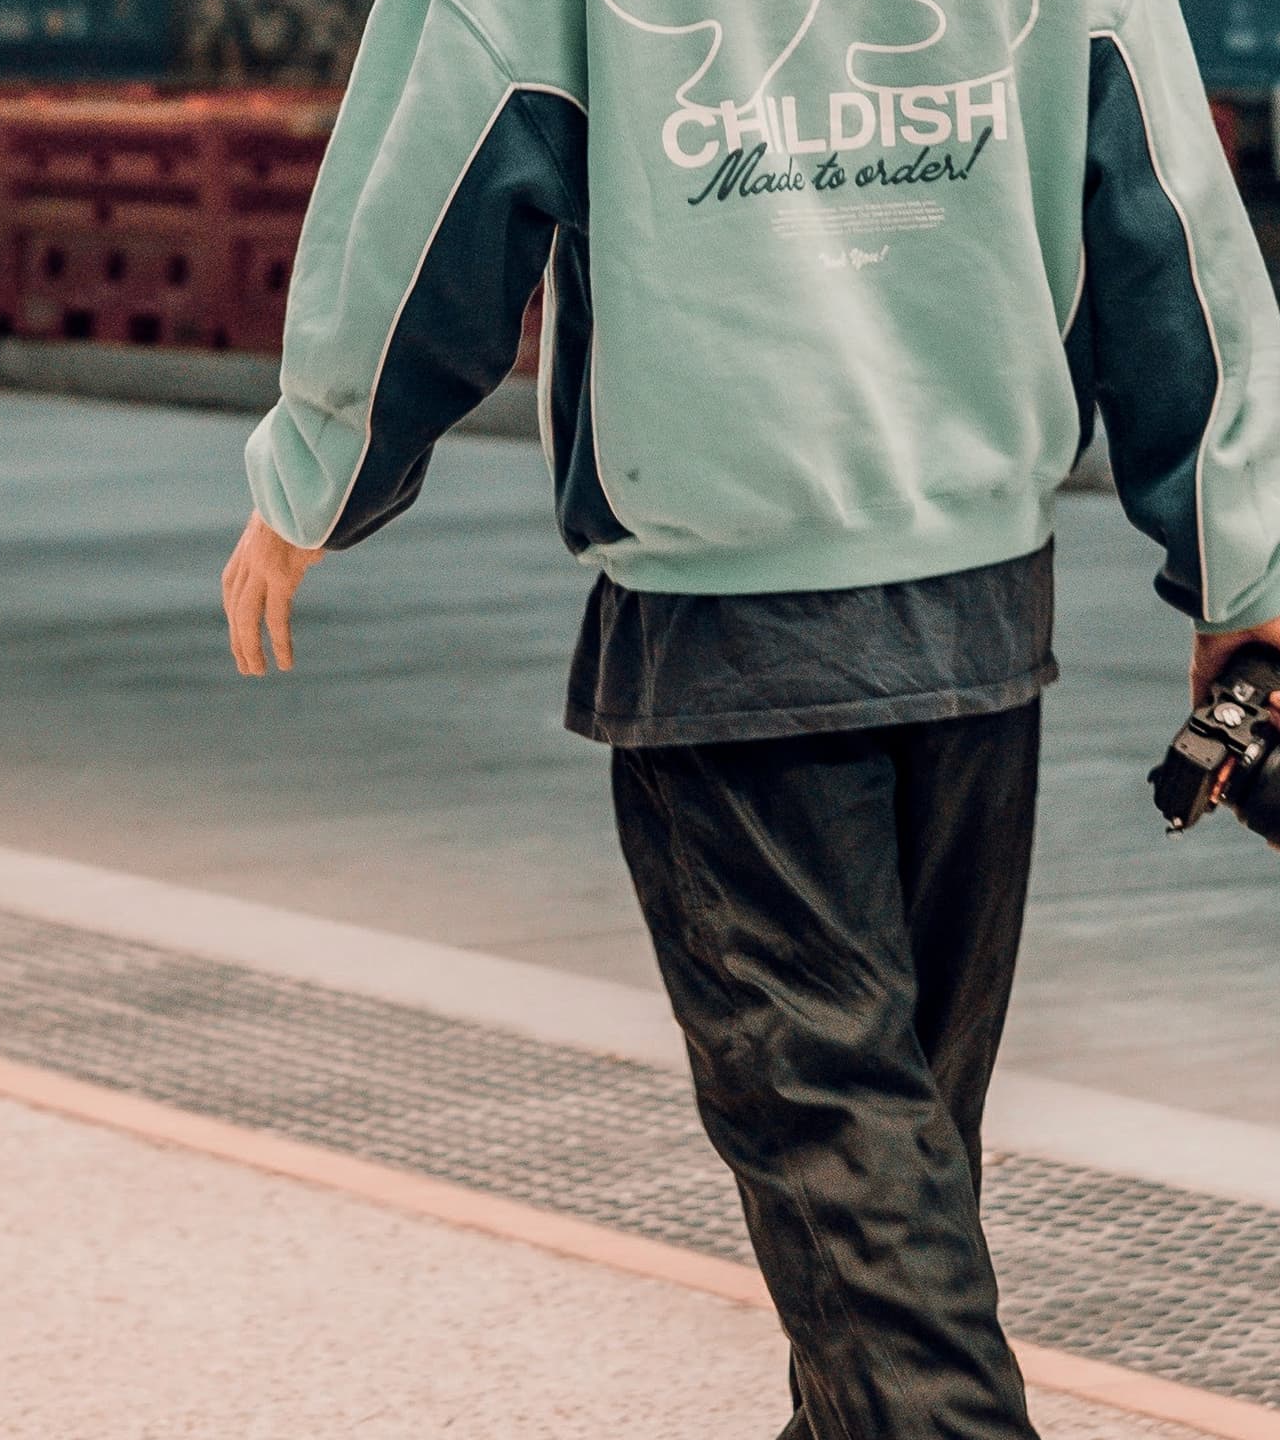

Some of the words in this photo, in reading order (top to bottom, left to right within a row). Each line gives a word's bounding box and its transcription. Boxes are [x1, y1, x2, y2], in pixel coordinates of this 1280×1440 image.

[661, 80, 1008, 169] CHILDISH
[686, 141, 806, 206] Made
[810, 152, 847, 191] to
[854, 126, 993, 188] order!
